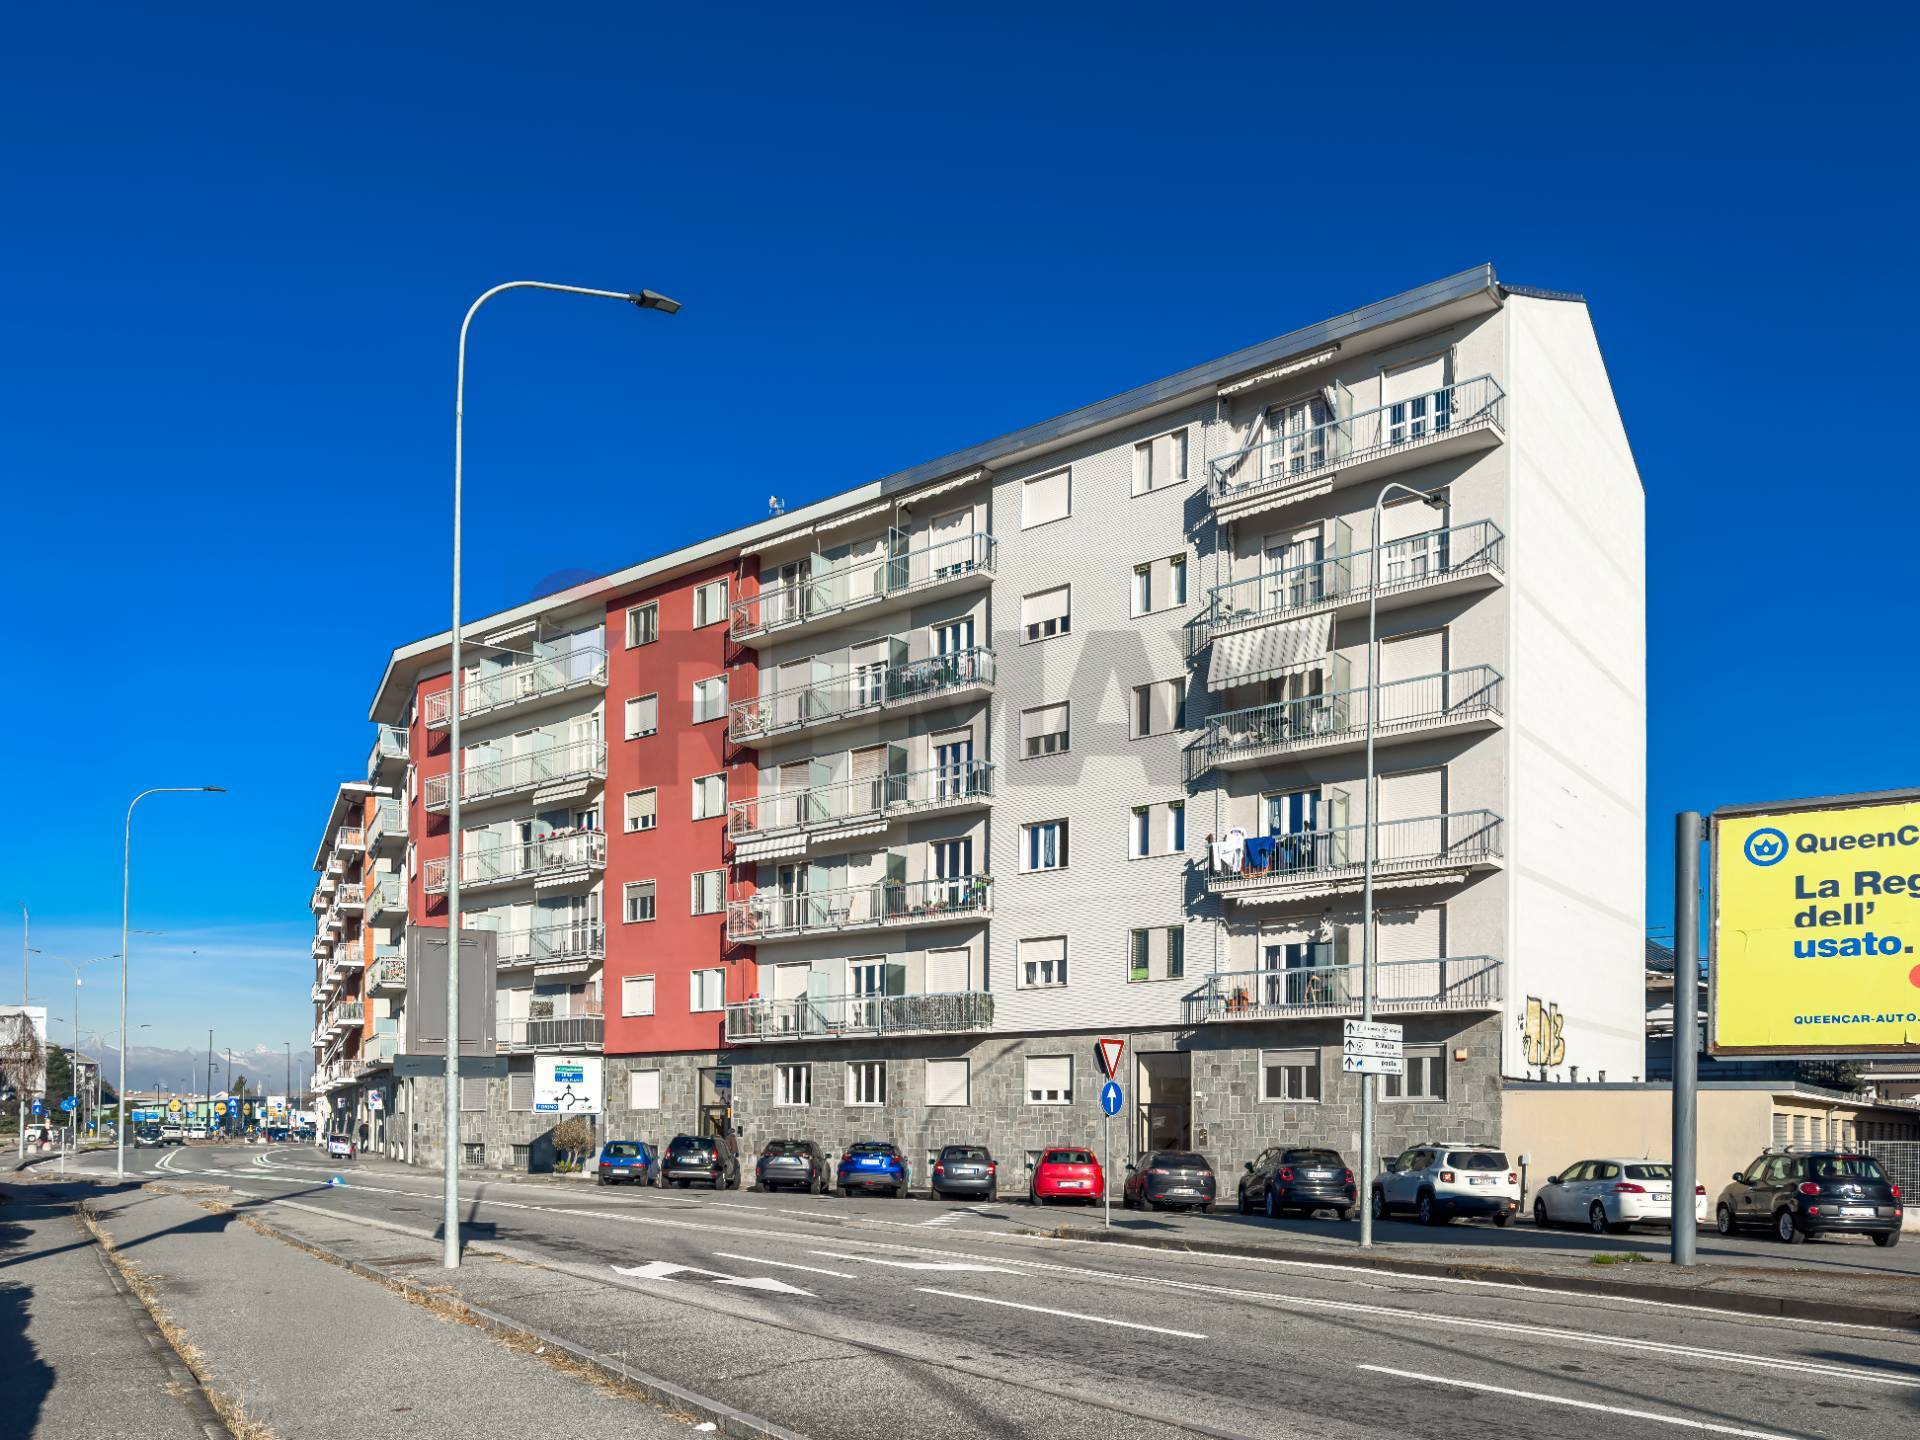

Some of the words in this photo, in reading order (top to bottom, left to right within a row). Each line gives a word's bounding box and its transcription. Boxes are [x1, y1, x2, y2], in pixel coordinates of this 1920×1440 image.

[1795, 825, 1919, 854] QueenC
[1795, 875, 1840, 899] La
[1855, 871, 1920, 898] Reg
[1794, 932, 1913, 958] usato.
